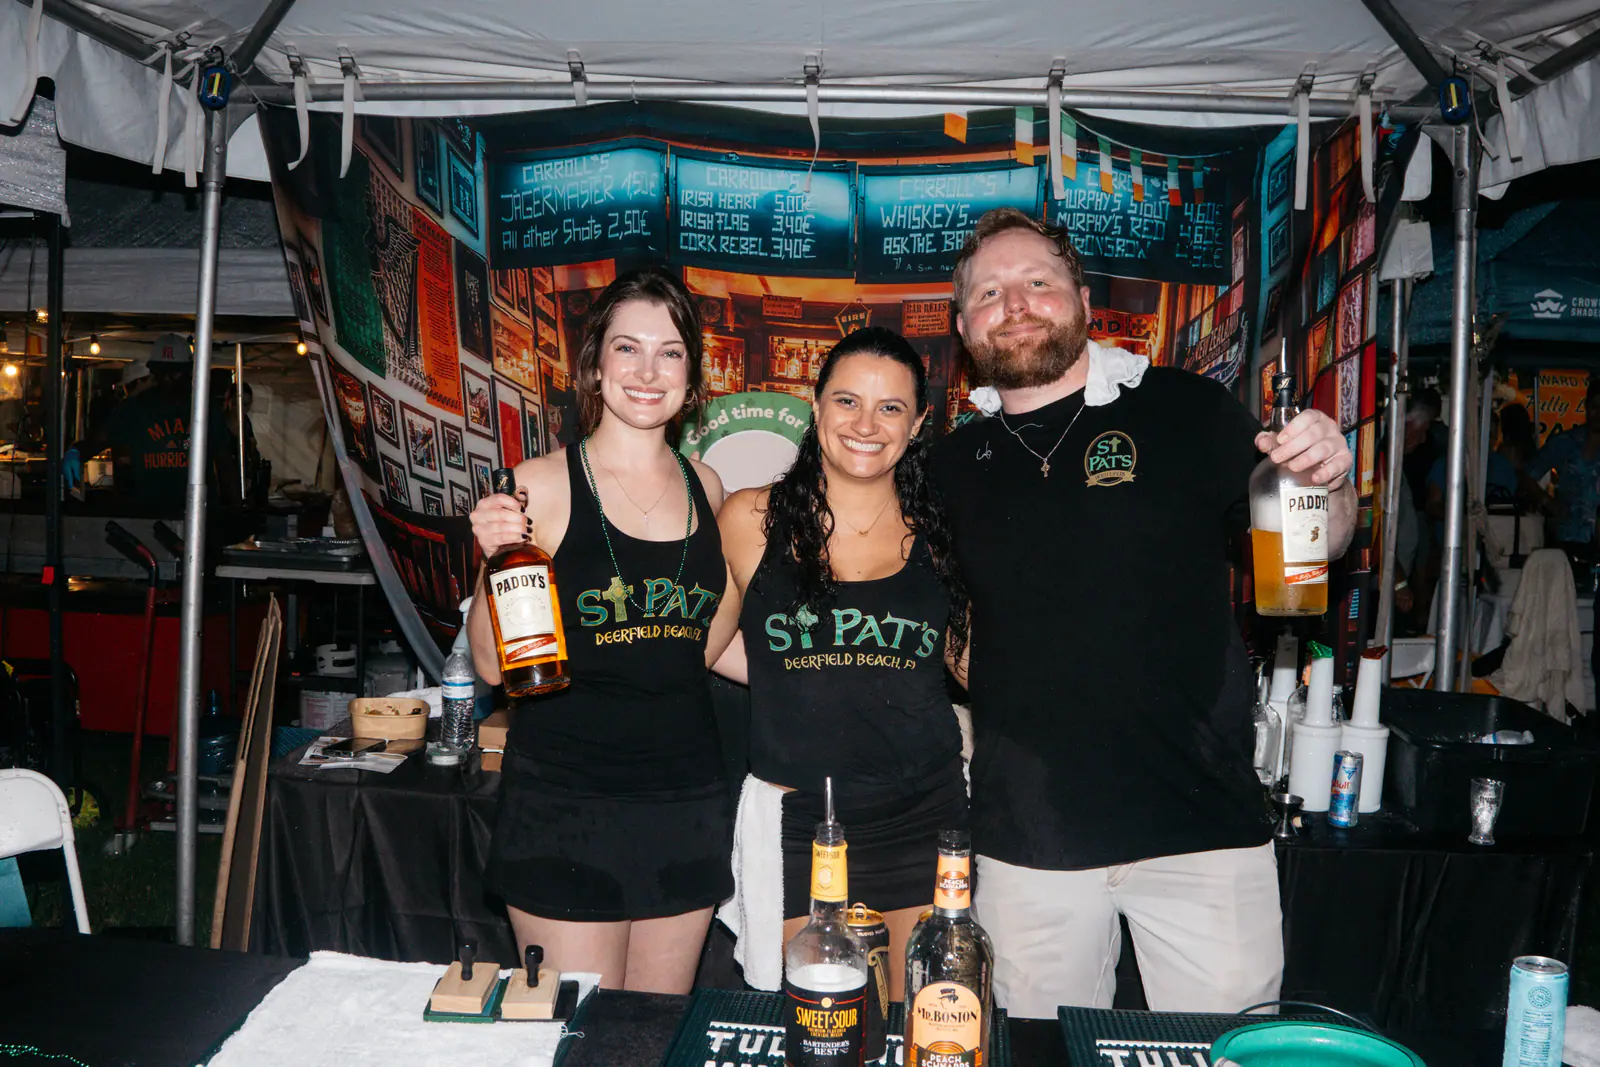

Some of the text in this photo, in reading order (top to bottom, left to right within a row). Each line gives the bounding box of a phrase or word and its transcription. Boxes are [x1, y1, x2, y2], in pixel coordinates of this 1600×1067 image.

[681, 189, 714, 208] IRISH
[718, 192, 760, 210] HEART
[502, 209, 652, 251] All other Shots 2,50€
[680, 209, 816, 235] IRISH FLAG 3,40€
[1129, 216, 1166, 242] RED
[679, 231, 817, 261] CORK REBEL 3,40€
[883, 236, 910, 255] ASK
[909, 232, 937, 254] THE
[685, 403, 805, 446] Good time for
[495, 571, 547, 598] PADDY'S
[595, 624, 661, 646] DEERFIELD
[831, 607, 940, 658] PAT'S
[784, 652, 854, 671] DEERFIELD
[802, 1039, 850, 1049] BARTENDER'S
[814, 1047, 839, 1056] BEST
[930, 1054, 962, 1063] PEACH
